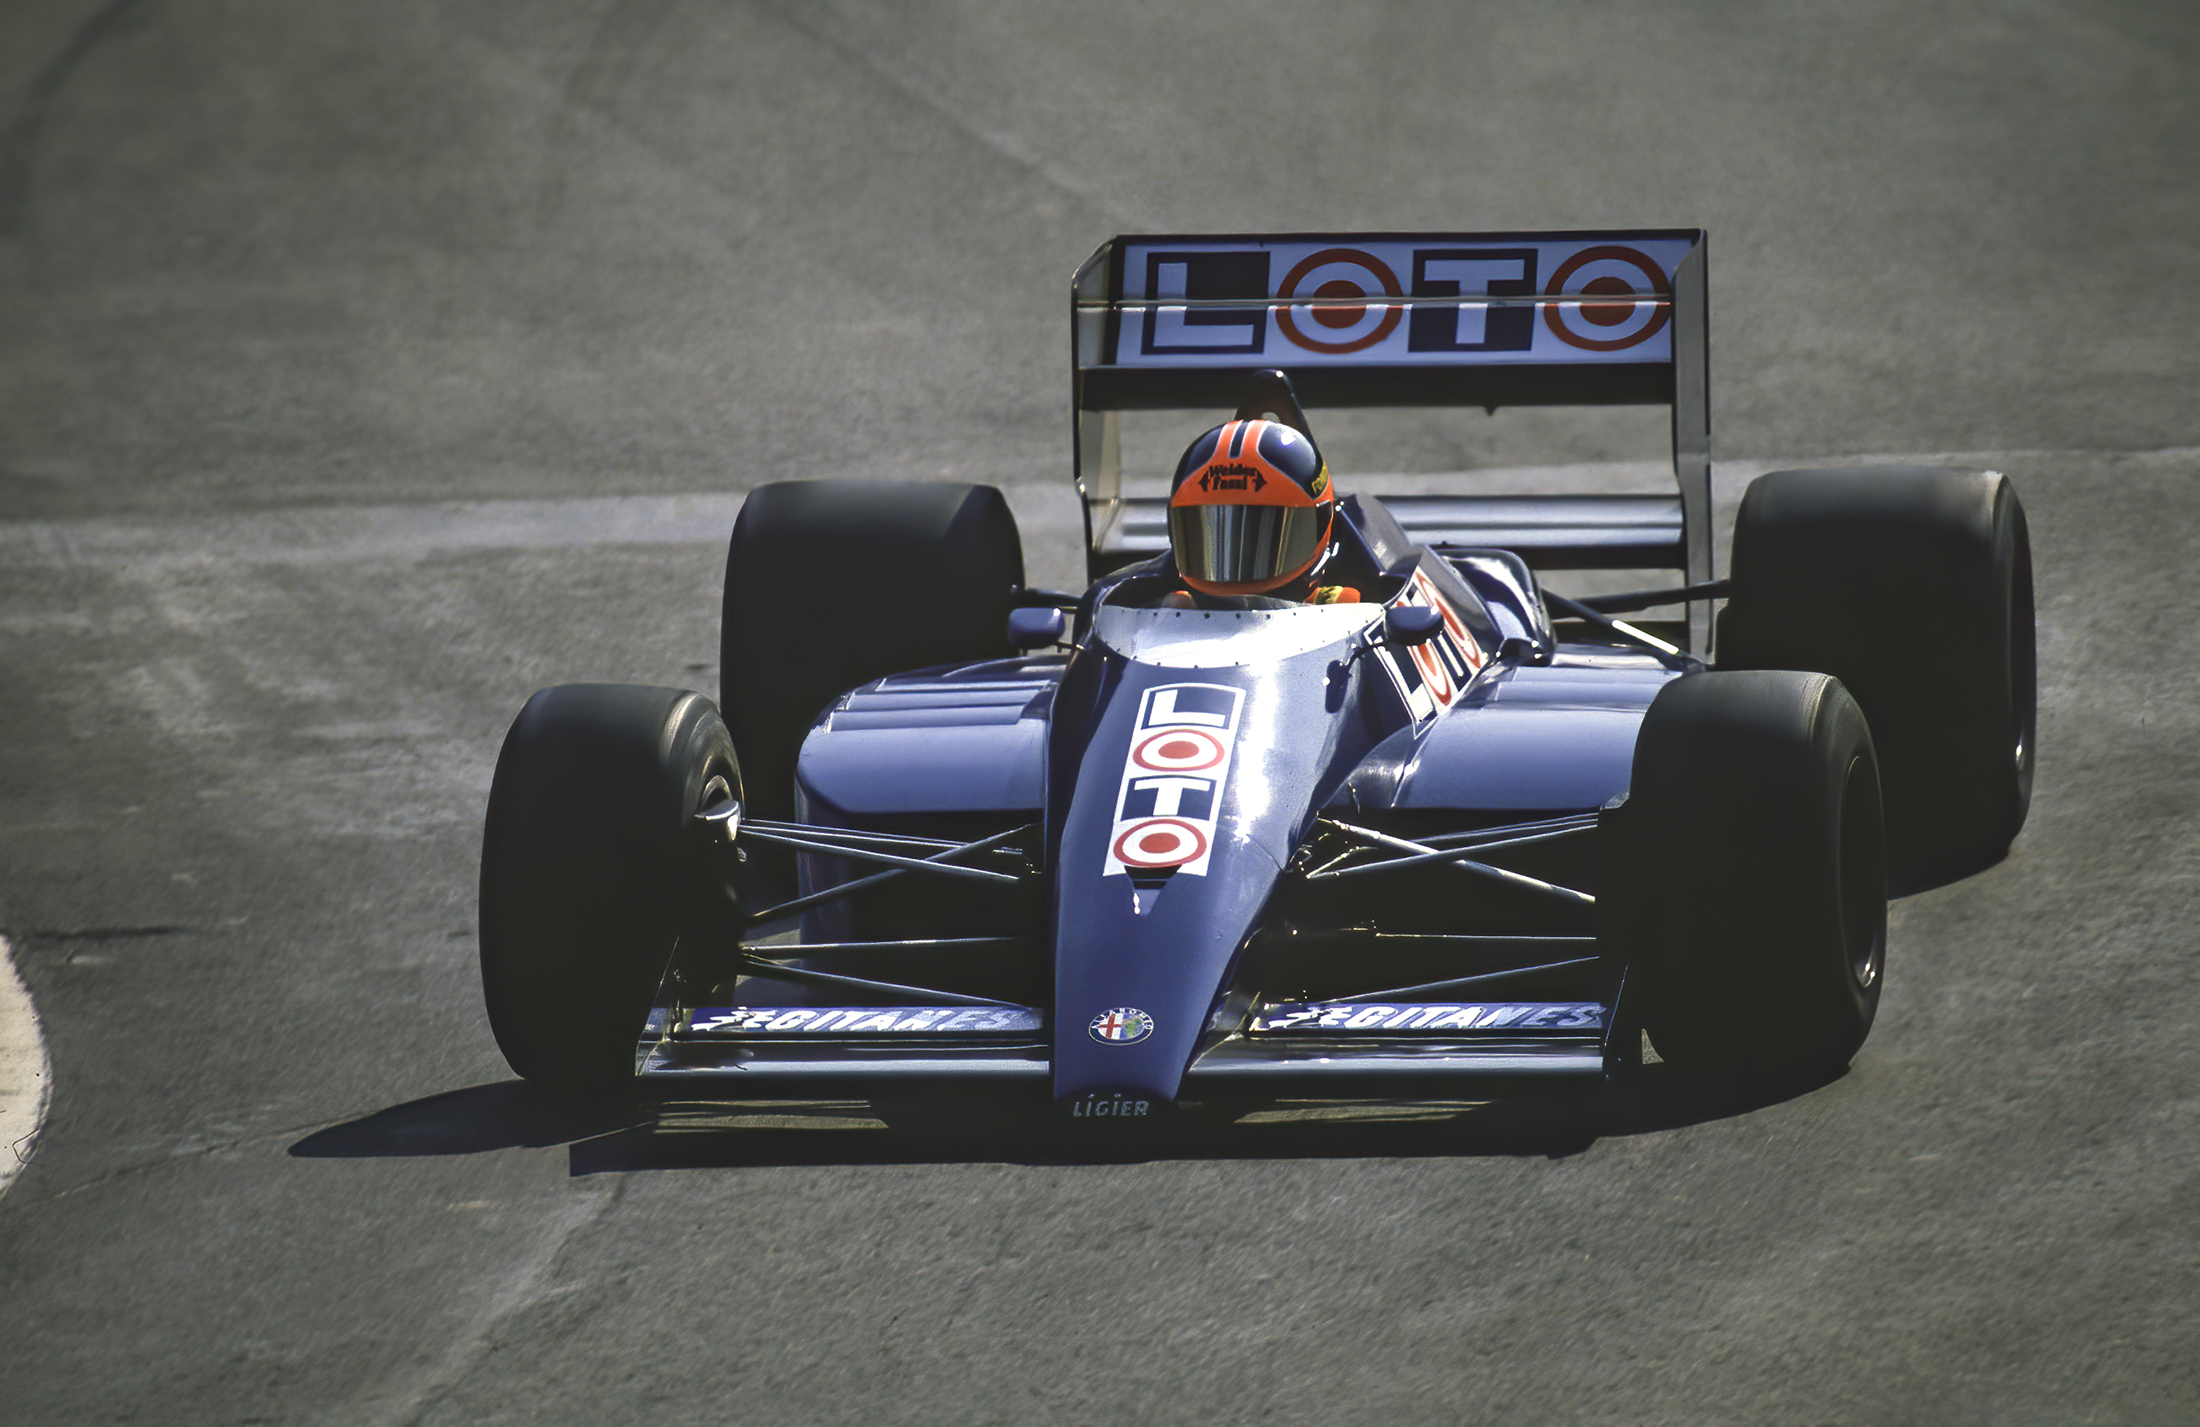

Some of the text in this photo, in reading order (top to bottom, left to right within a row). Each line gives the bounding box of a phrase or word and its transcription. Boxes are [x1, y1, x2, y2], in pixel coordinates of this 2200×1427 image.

[1153, 245, 1671, 355] LOTO
[1113, 688, 1226, 868] LOTO
[1343, 1005, 1604, 1029] GITANES
[1073, 1100, 1149, 1118] LIGIER
